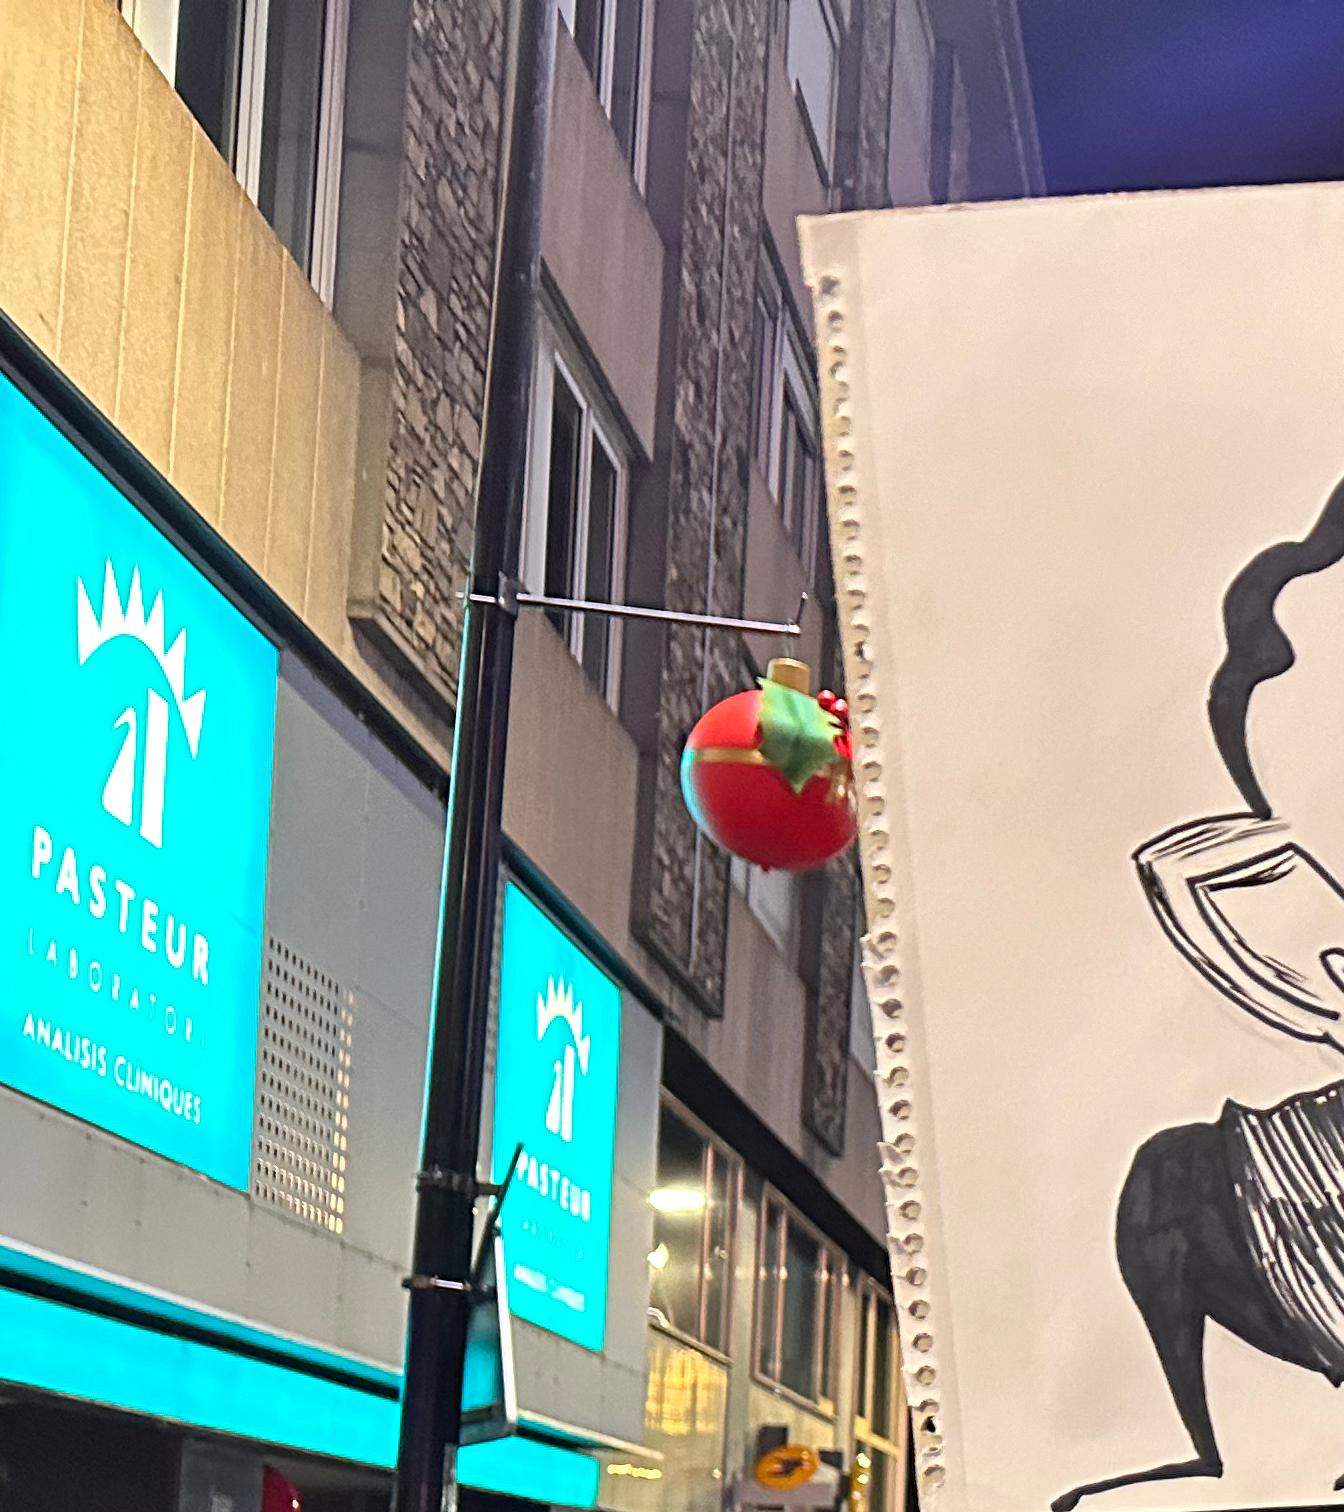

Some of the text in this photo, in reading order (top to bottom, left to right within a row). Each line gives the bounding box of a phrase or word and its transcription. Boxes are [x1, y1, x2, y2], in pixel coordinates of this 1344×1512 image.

[31, 825, 210, 986] PASTEUR
[28, 927, 207, 1048] LABORATOR
[23, 1013, 202, 1124] ANALISIS CLINIQUES
